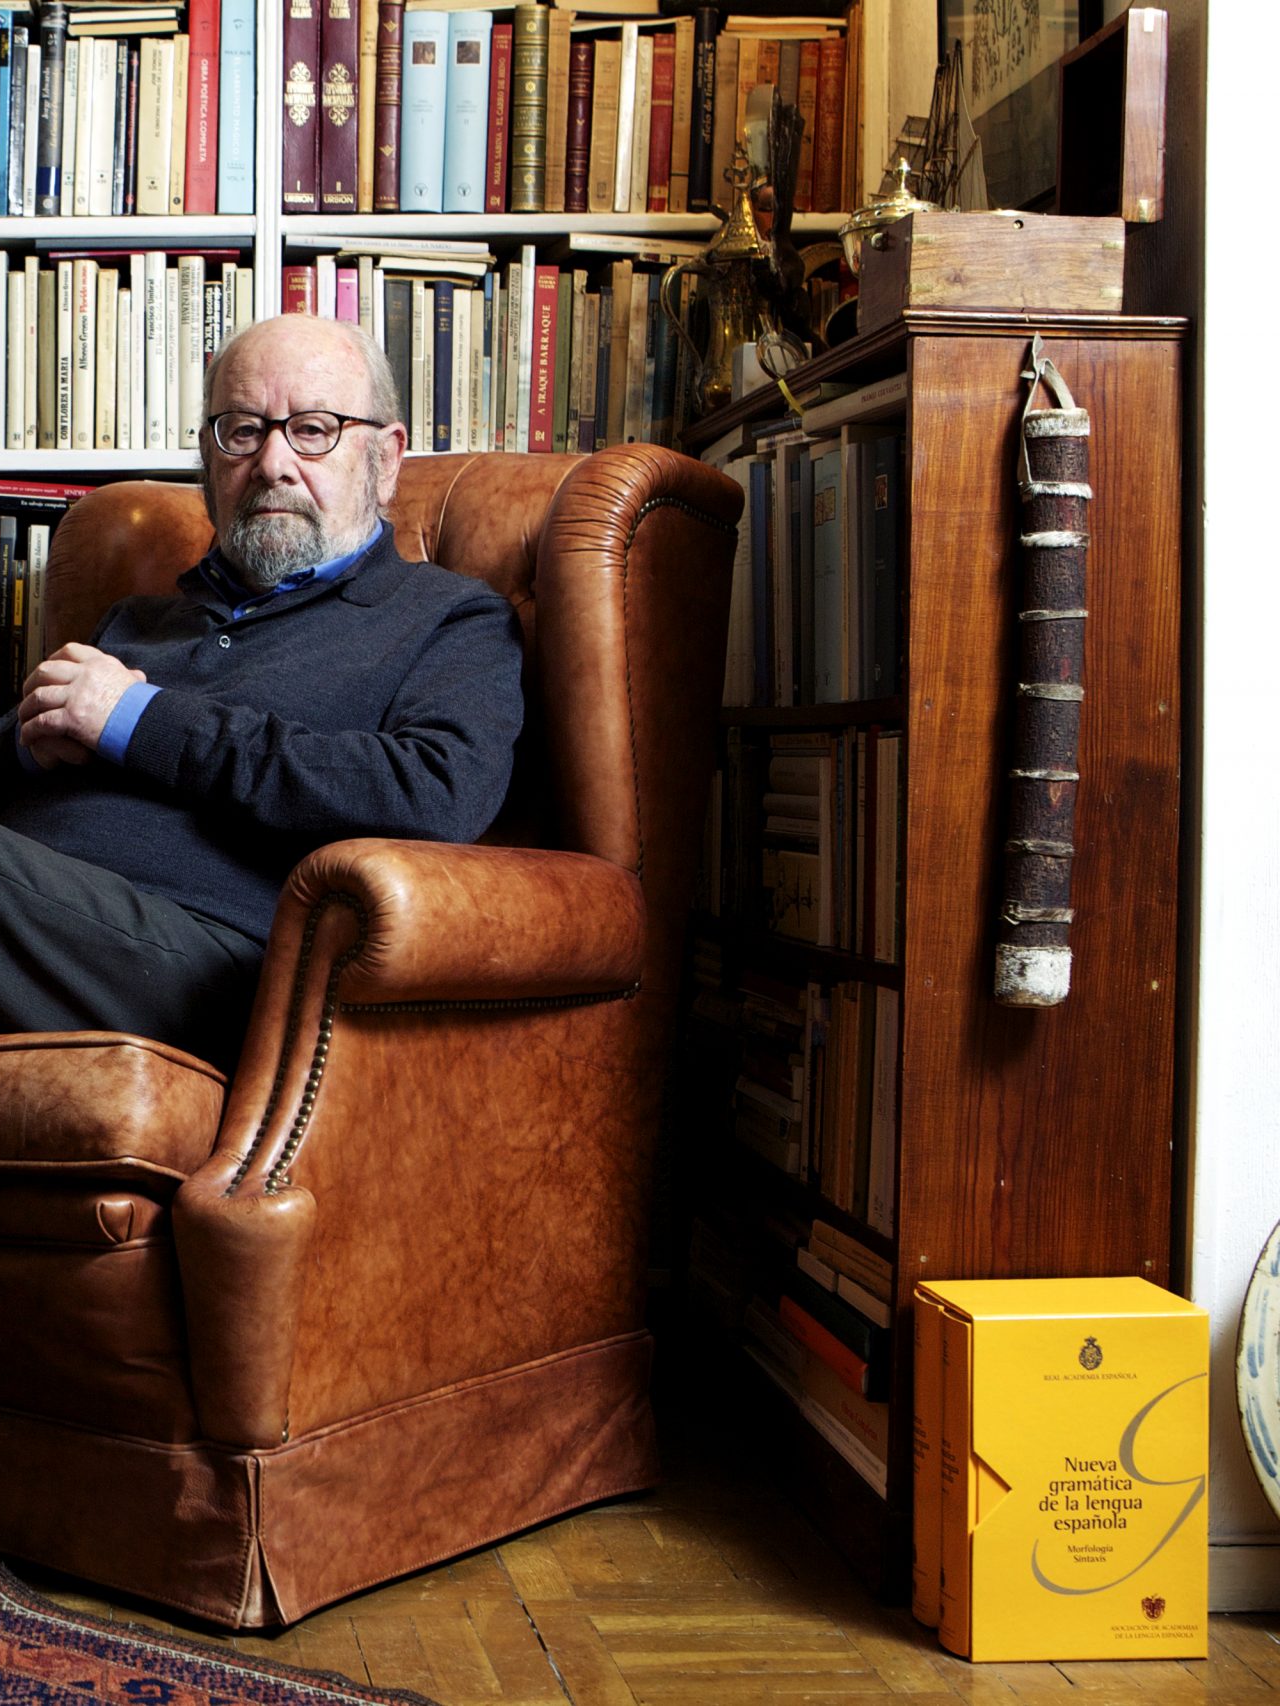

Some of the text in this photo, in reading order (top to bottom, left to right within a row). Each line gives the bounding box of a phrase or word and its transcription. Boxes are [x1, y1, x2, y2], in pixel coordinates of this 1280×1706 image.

[201, 59, 209, 81] OBRA
[496, 117, 503, 125] EL
[199, 121, 207, 162] COMPLETA
[539, 305, 551, 366] BARRAQUE
[79, 343, 88, 370] Alfonso
[1102, 1372, 1137, 1380] ESPAÑOLA
[1064, 1456, 1117, 1472] Nueva
[1049, 1474, 1132, 1496] gramática
[1038, 1495, 1142, 1514] de la lengua
[1054, 1511, 1127, 1534] española
[1074, 1554, 1106, 1562] Sintaxis
[1162, 1631, 1194, 1640] ESPAÑOLA
